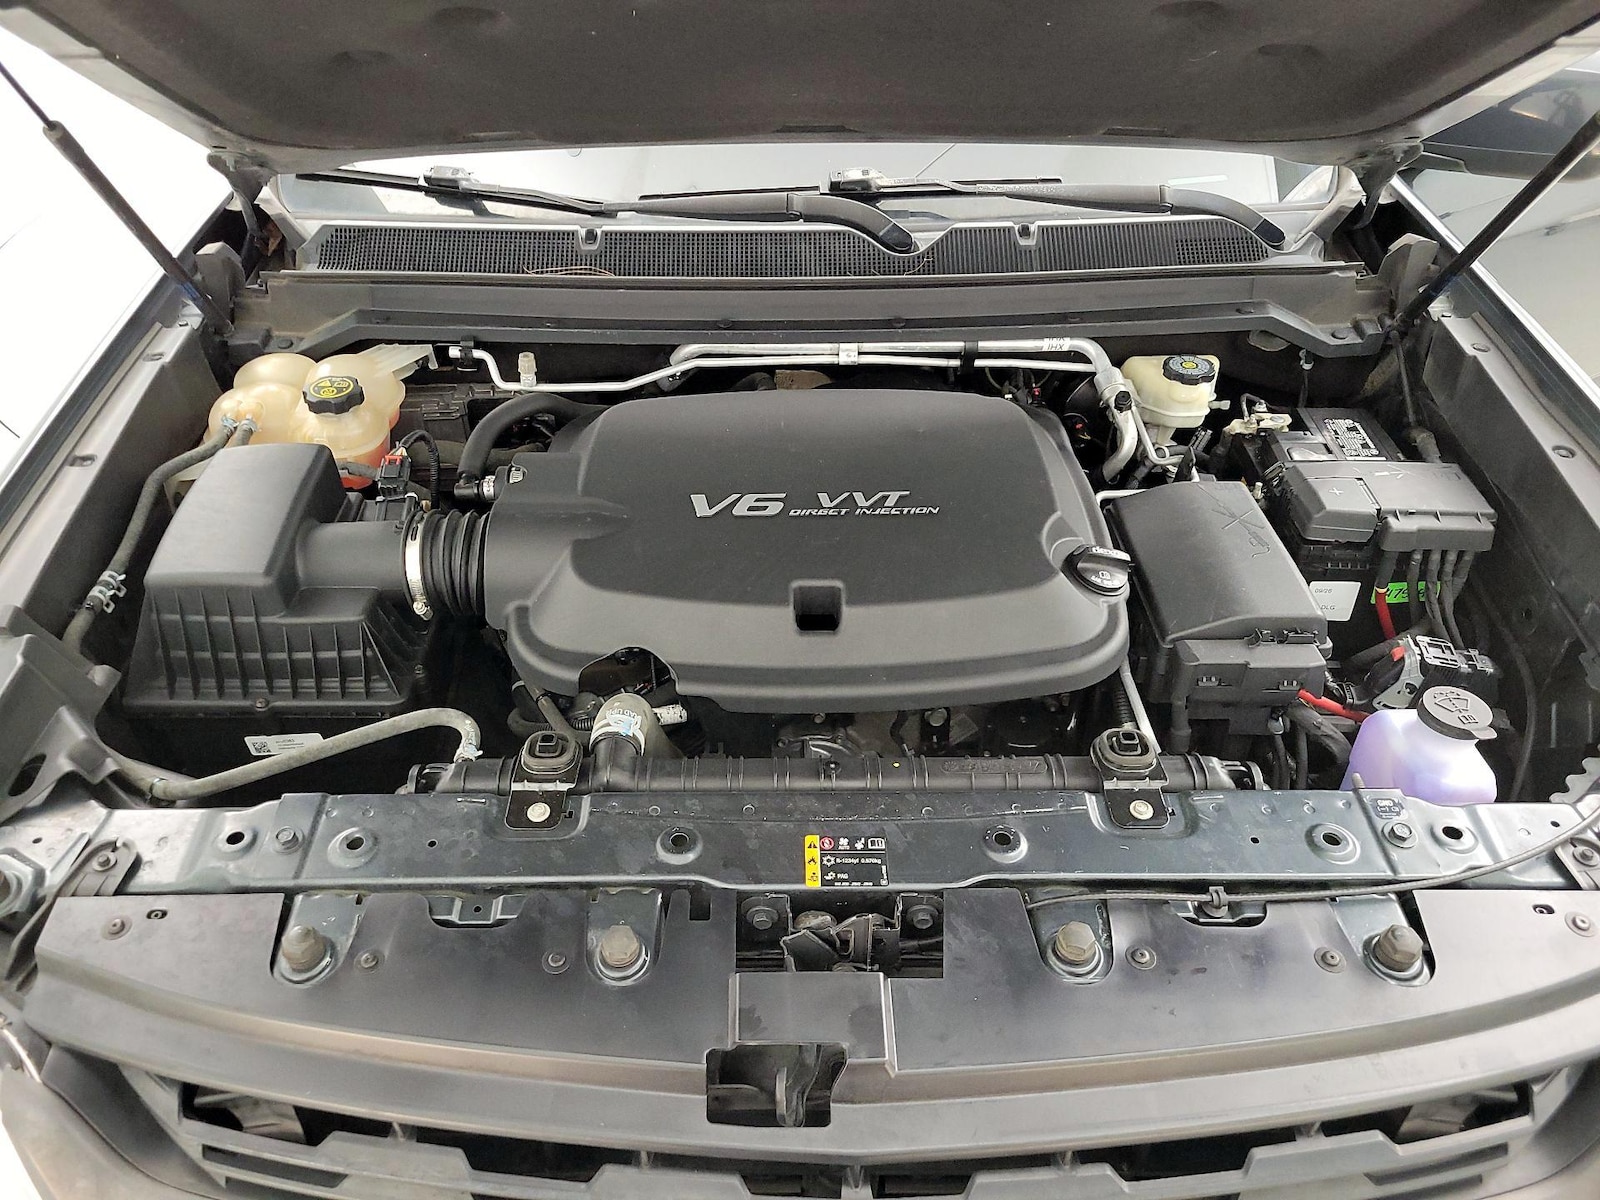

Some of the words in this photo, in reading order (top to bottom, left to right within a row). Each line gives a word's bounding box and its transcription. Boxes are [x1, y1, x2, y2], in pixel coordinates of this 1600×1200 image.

[690, 493, 787, 517] V6
[816, 491, 910, 508] VVT
[788, 508, 850, 517] DIRECT
[854, 506, 940, 516] INJECTION
